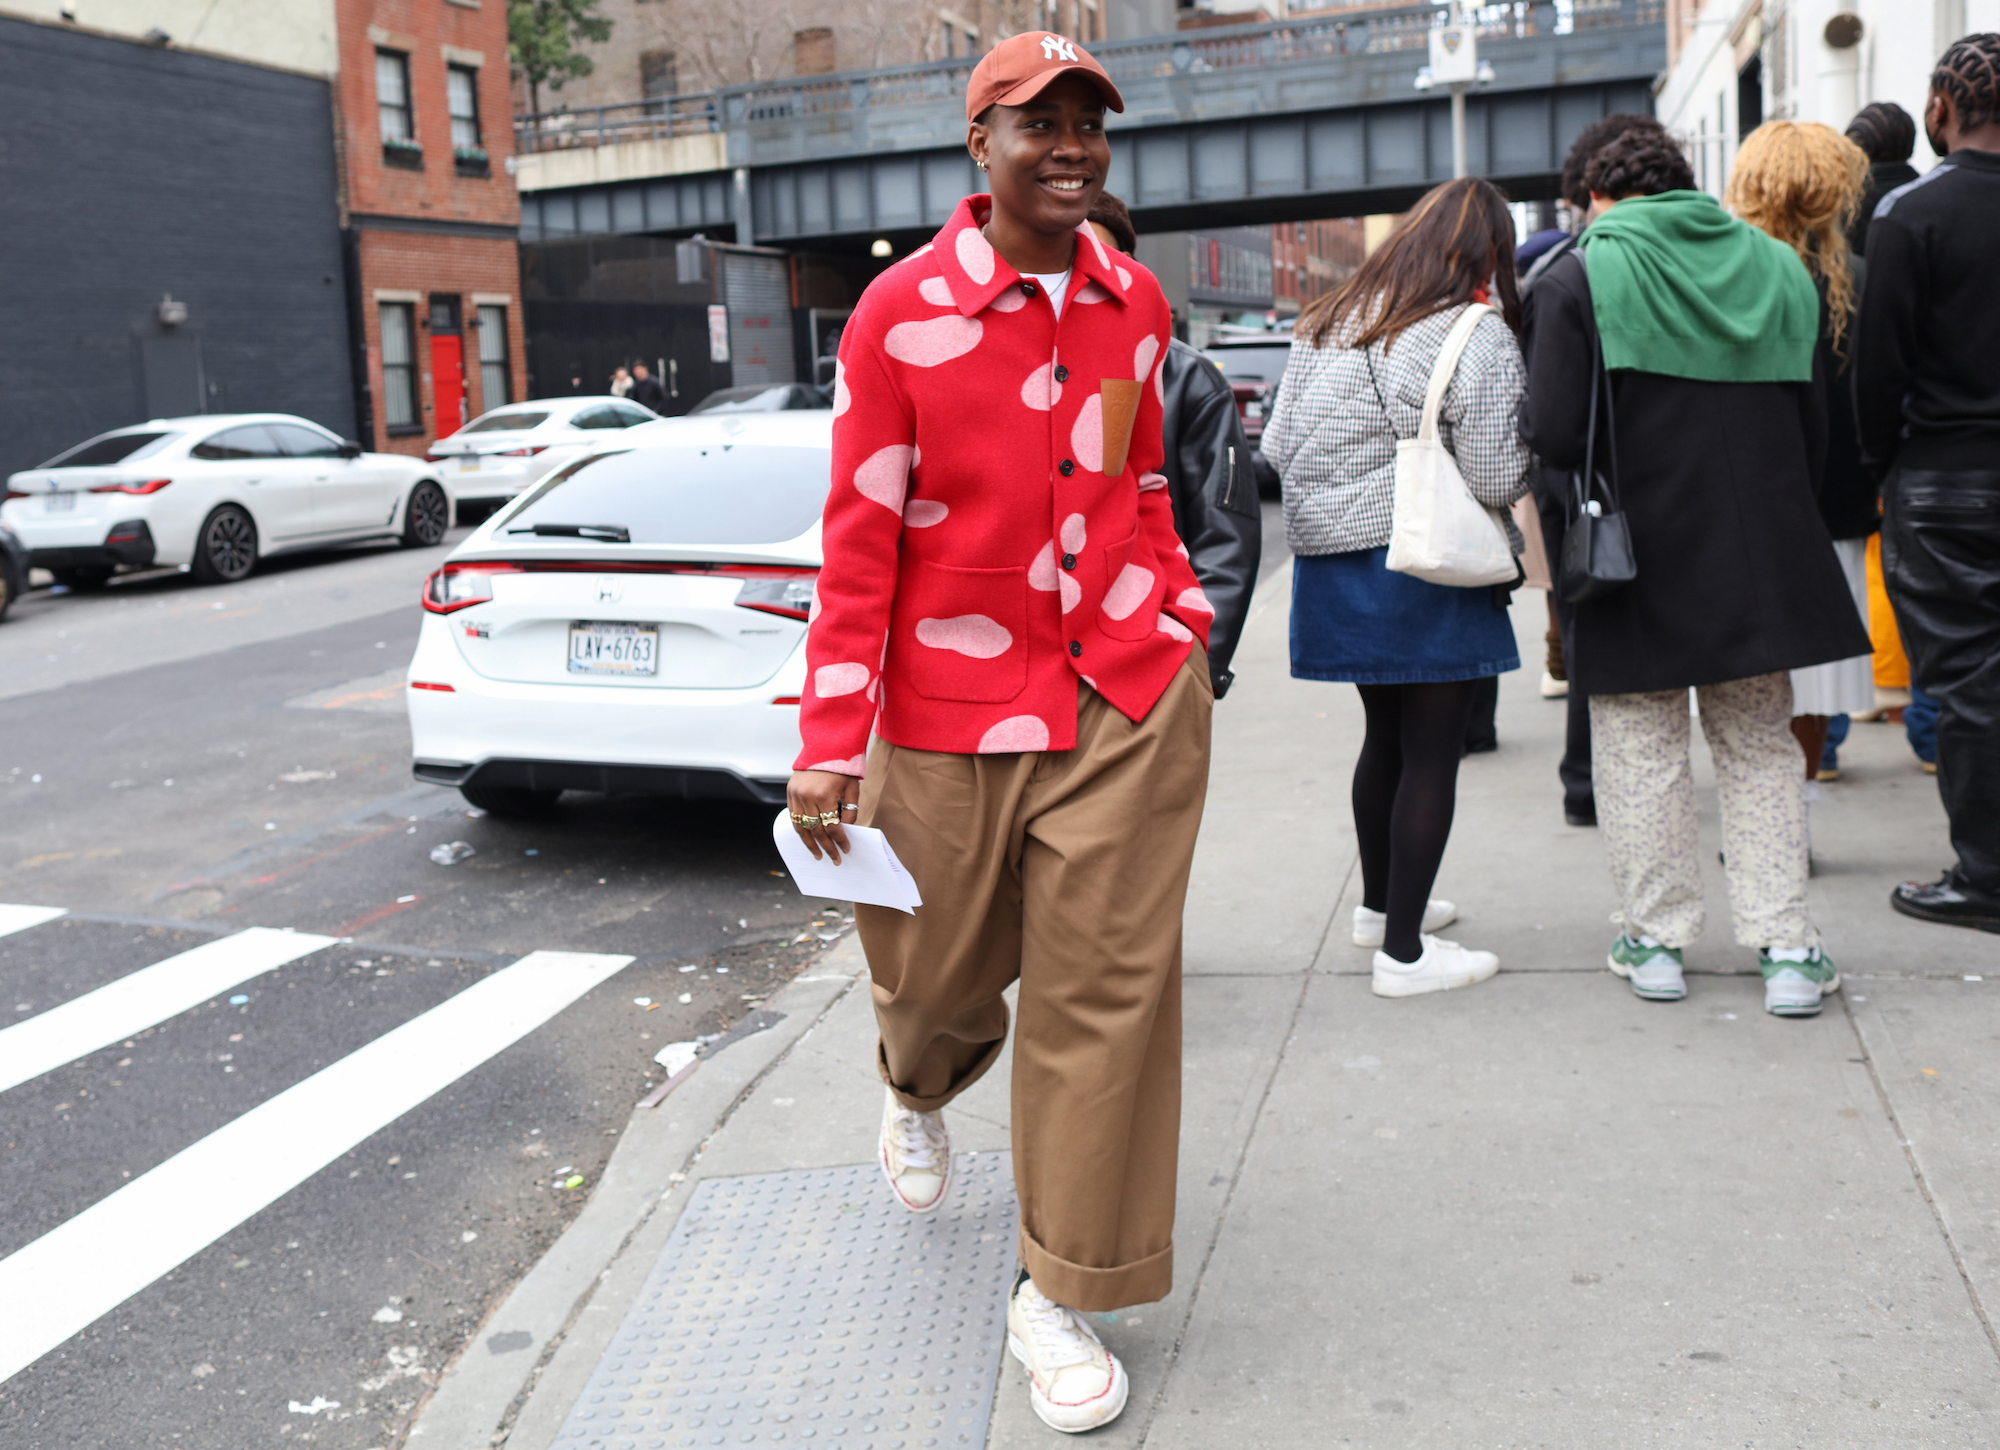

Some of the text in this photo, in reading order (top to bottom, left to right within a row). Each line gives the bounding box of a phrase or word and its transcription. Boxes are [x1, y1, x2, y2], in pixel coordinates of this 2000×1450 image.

[1040, 35, 1079, 63] NY
[592, 626, 636, 636] NEW YORK
